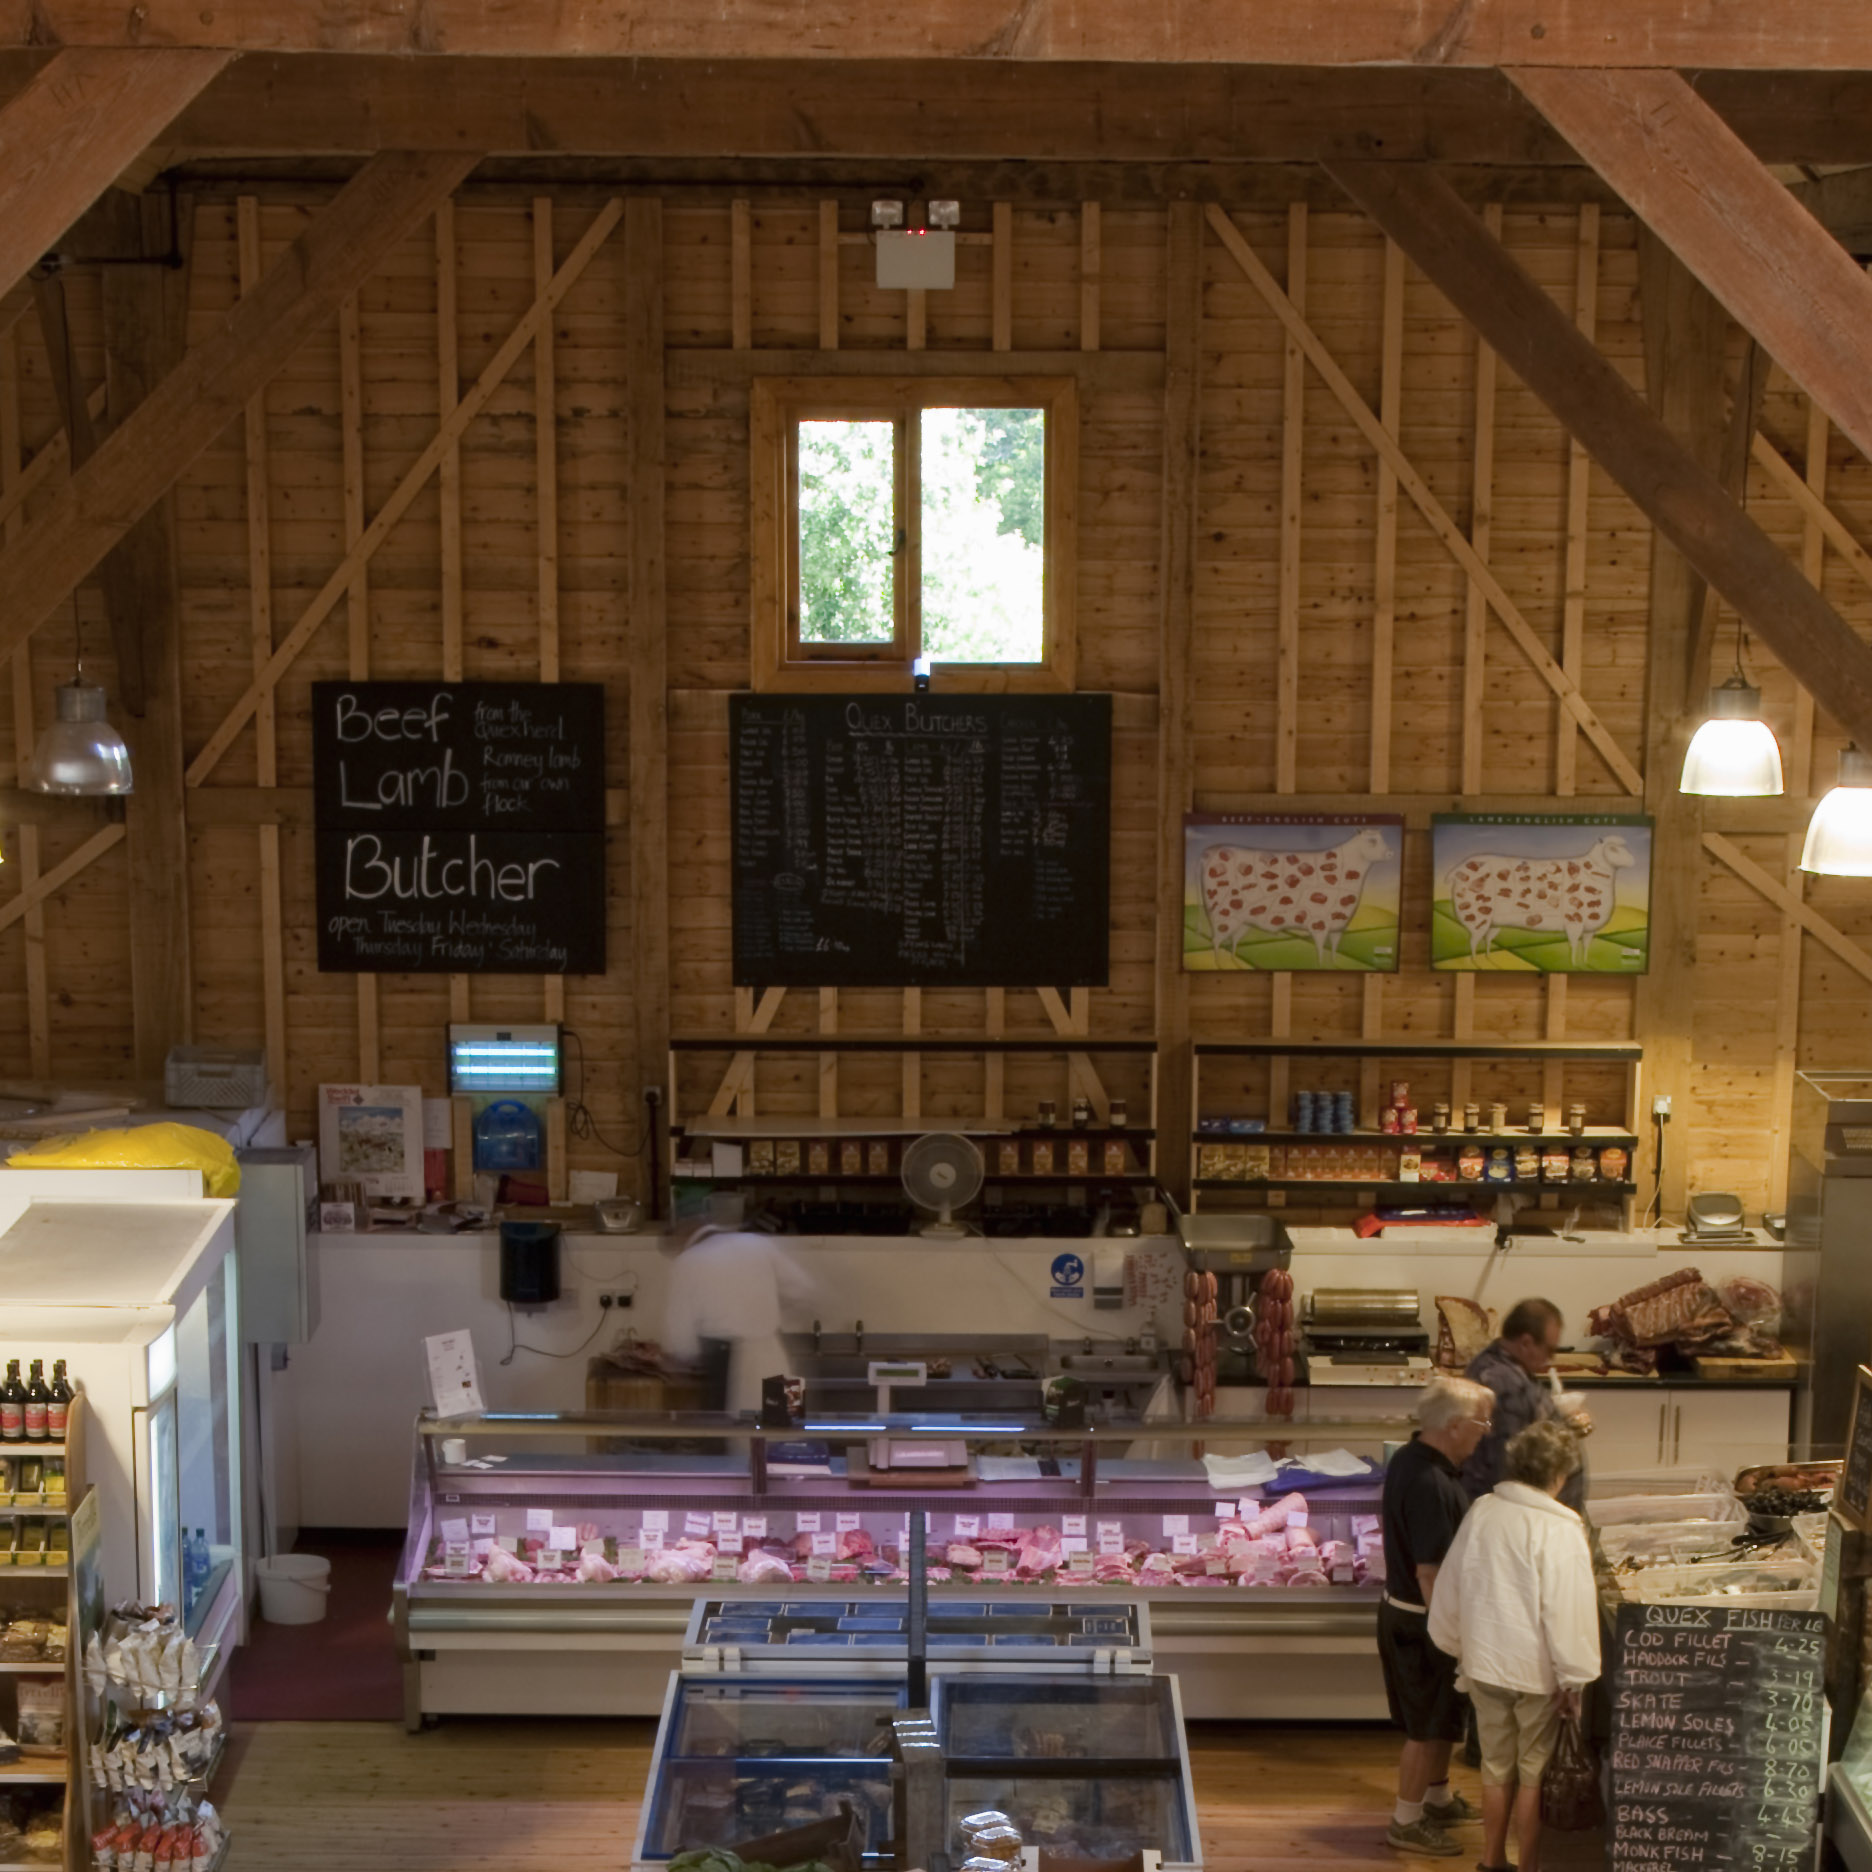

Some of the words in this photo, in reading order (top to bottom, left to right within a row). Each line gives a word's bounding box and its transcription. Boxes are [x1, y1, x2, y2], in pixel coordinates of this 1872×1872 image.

[336, 692, 453, 742] Beef
[483, 746, 543, 776] Romney
[340, 748, 470, 809] Lamb
[346, 833, 560, 900] Butcher
[328, 913, 369, 942] open
[378, 910, 441, 937] Tuesday
[449, 909, 536, 937] Wednesday
[352, 936, 424, 967] Thursday
[431, 935, 485, 967] Friday
[499, 938, 567, 971] Saturday
[1646, 1604, 1711, 1627] QUEX
[1727, 1609, 1773, 1631] FISH
[1624, 1630, 1664, 1647] COD
[1675, 1632, 1732, 1649] FILLET
[1623, 1649, 1689, 1667] HADDOCK
[1695, 1651, 1726, 1668] FILS
[1625, 1669, 1692, 1686] TROUT
[1616, 1690, 1683, 1709] SKATE
[1620, 1712, 1676, 1729] LEMON
[1683, 1713, 1734, 1736] SOLES
[1613, 1752, 1640, 1769] RED
[1617, 1805, 1669, 1824] BASS
